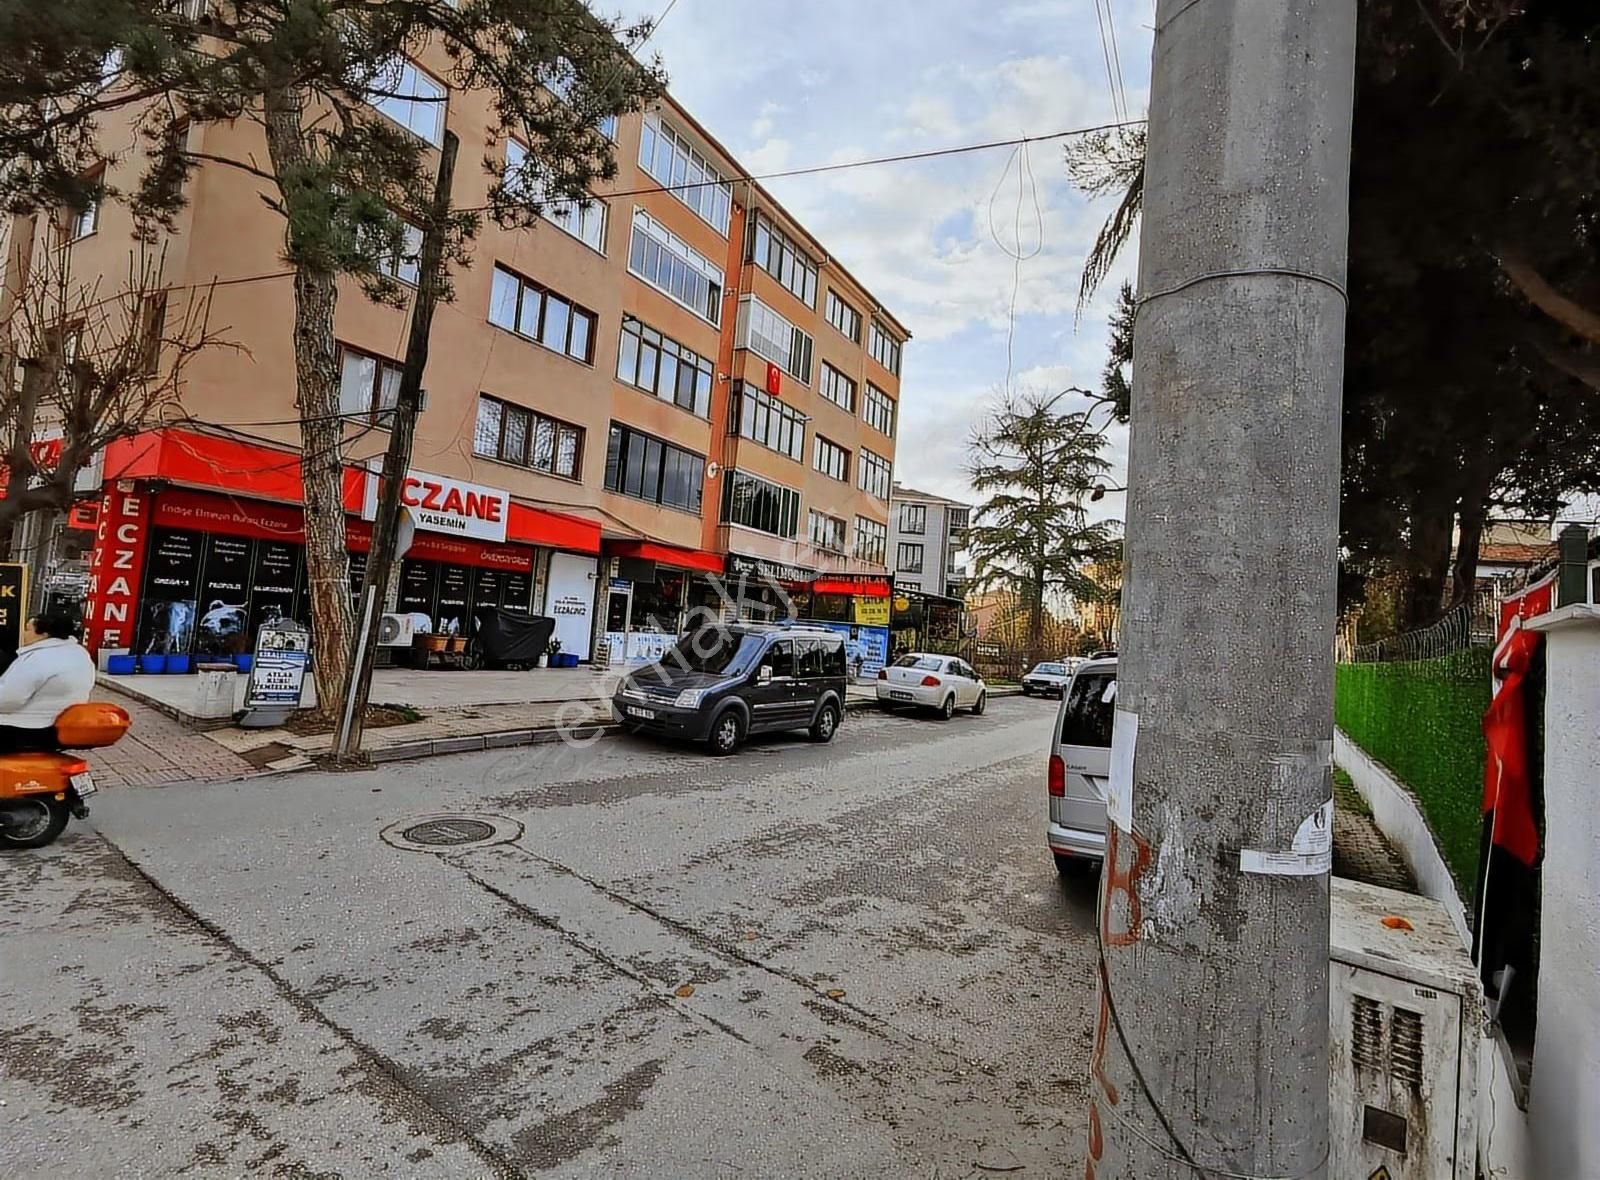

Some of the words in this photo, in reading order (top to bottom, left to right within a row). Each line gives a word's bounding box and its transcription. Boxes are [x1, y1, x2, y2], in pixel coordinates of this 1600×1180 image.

[378, 474, 502, 523] CZANE
[419, 512, 466, 530] YASEMİN
[103, 498, 141, 647] ECZANE
